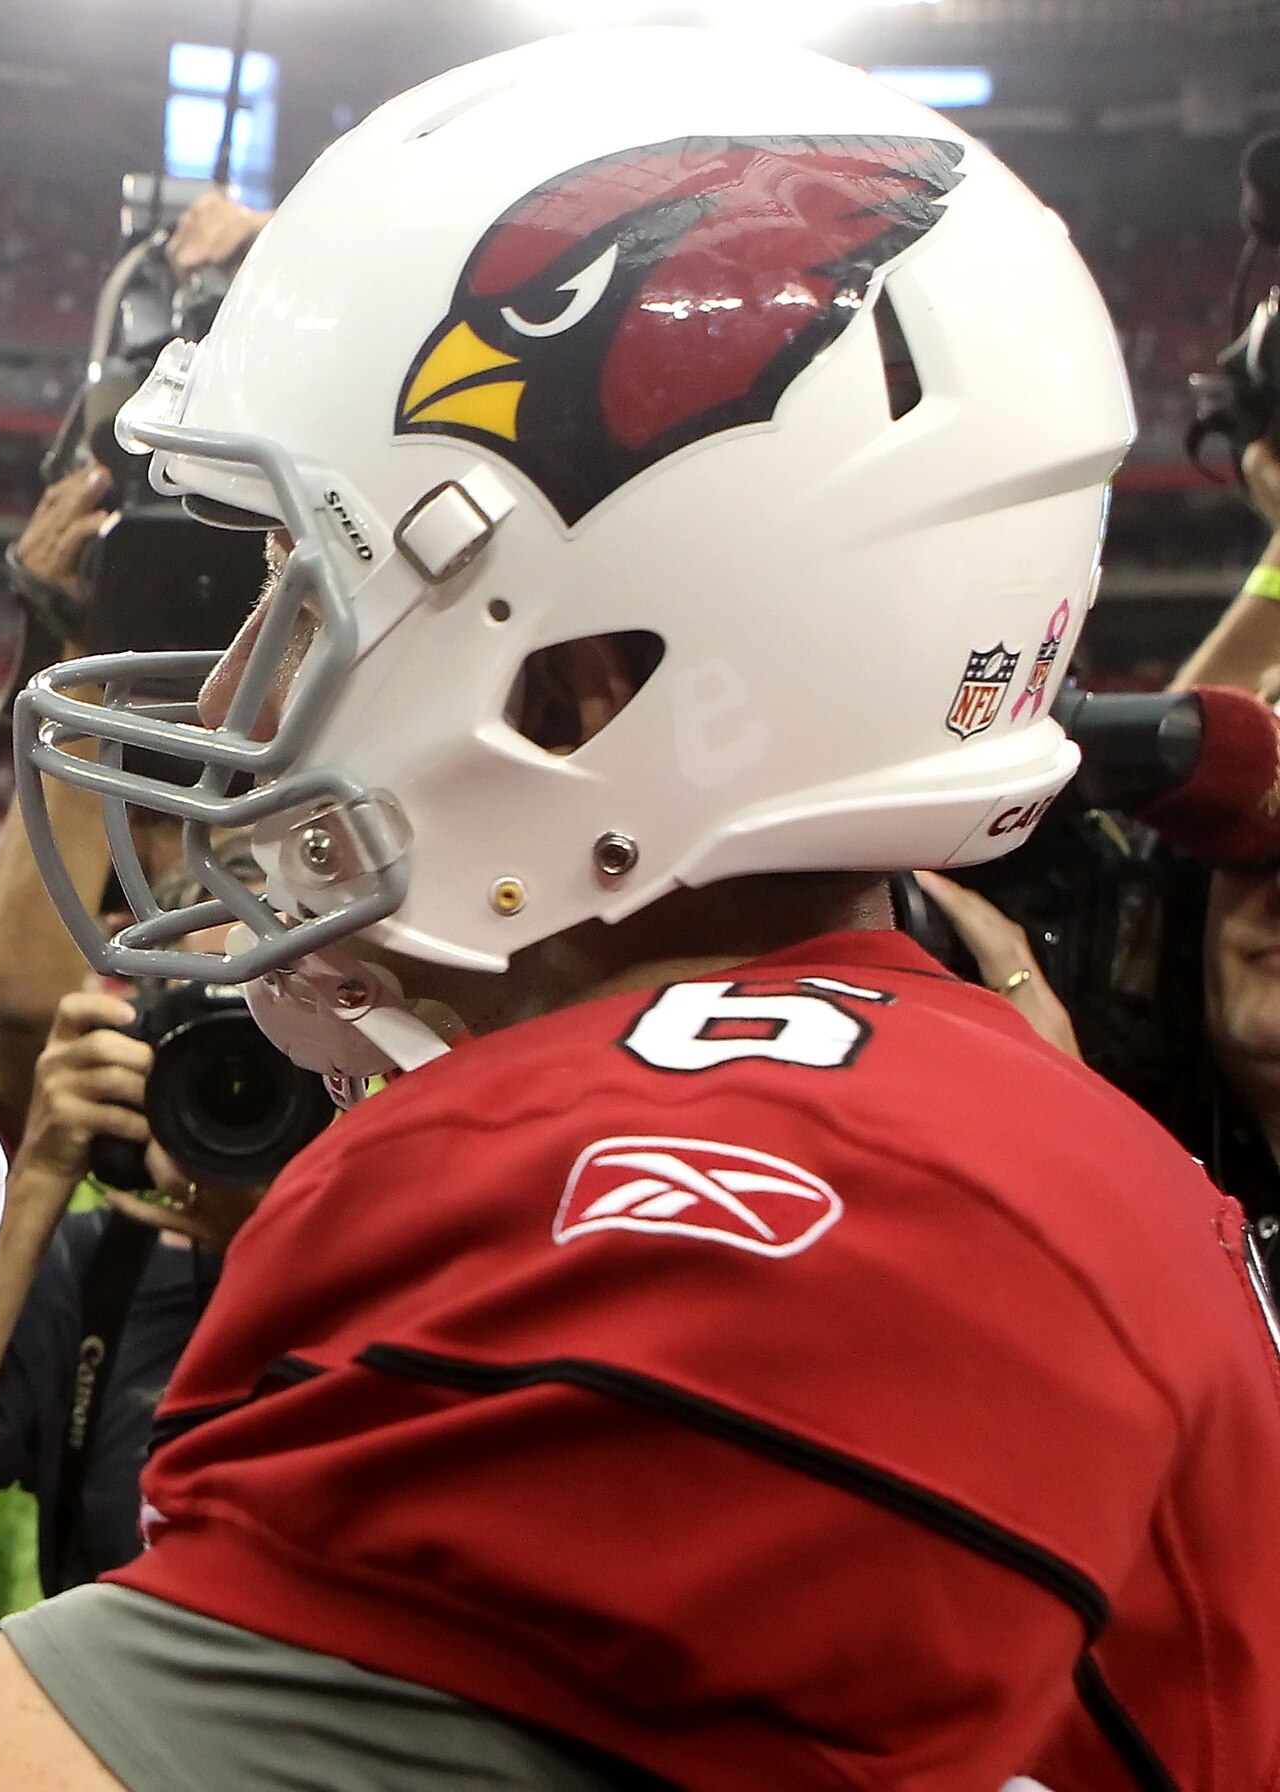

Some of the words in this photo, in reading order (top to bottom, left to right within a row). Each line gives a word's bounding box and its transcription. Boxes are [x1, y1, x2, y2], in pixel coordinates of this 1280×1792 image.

[323, 488, 373, 561] SPEED
[950, 685, 1000, 730] NFL
[616, 976, 896, 1072] 6
